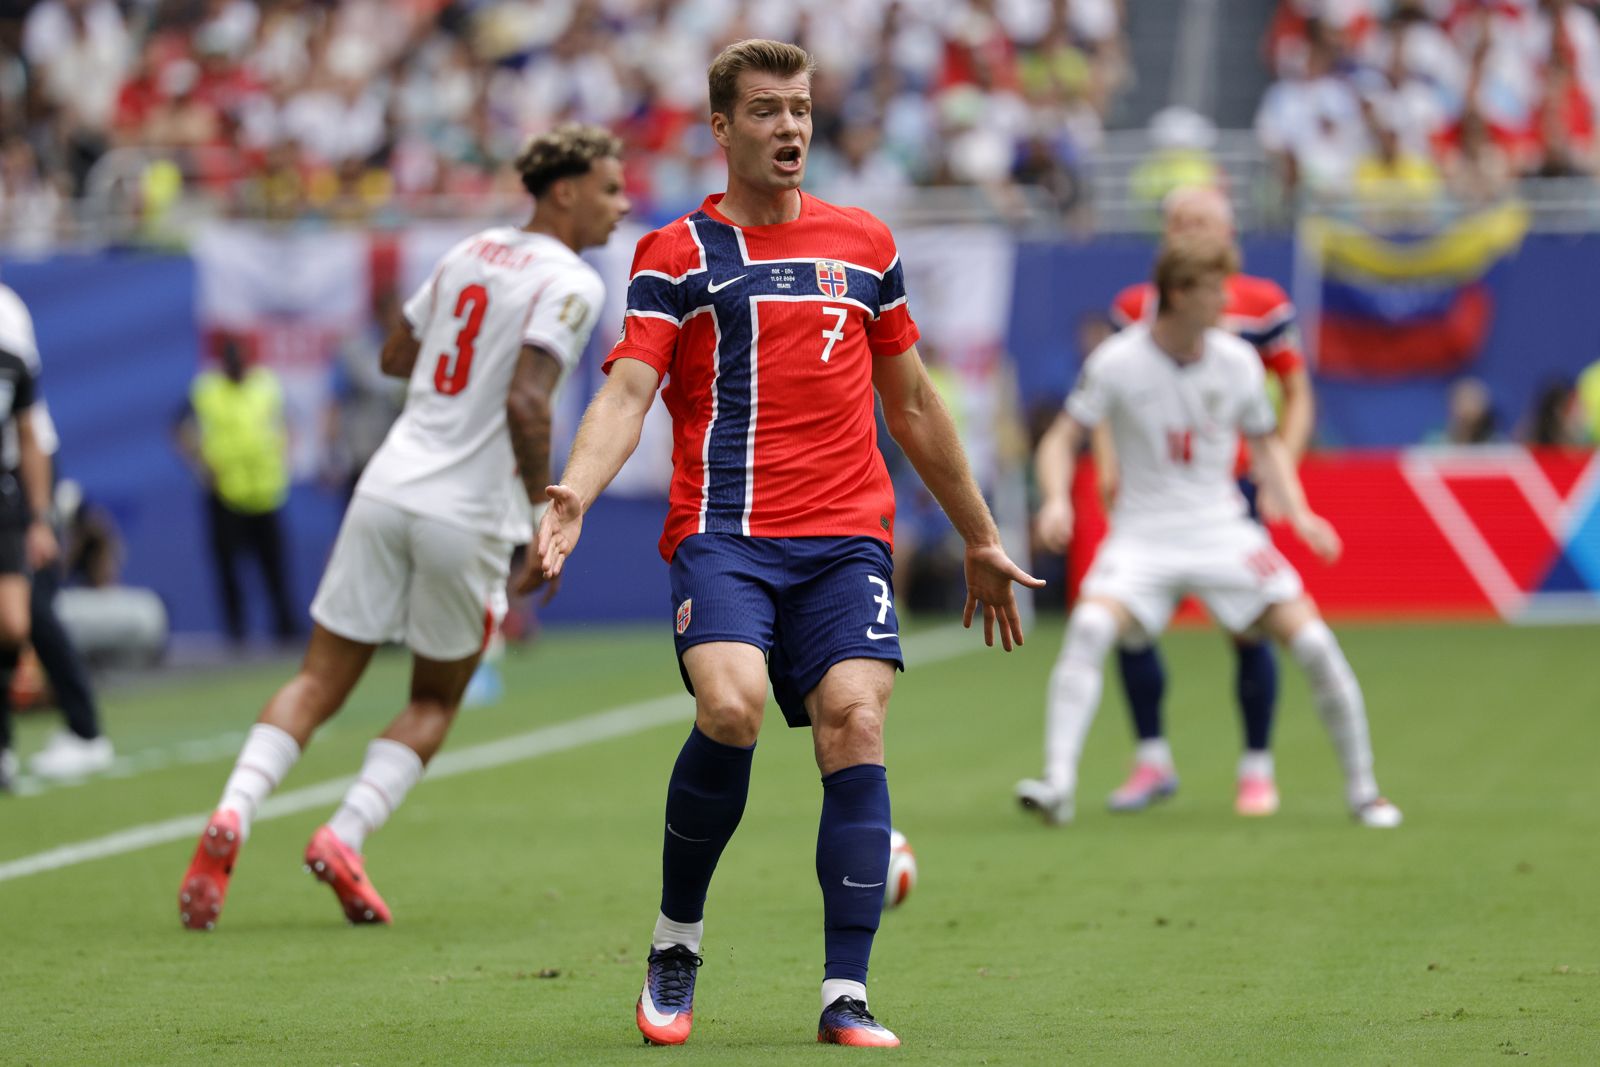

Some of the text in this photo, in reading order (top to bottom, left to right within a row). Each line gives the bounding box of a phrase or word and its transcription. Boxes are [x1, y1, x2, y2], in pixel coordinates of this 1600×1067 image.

[434, 283, 488, 396] 3
[820, 306, 848, 363] 7
[867, 575, 892, 625] 7
